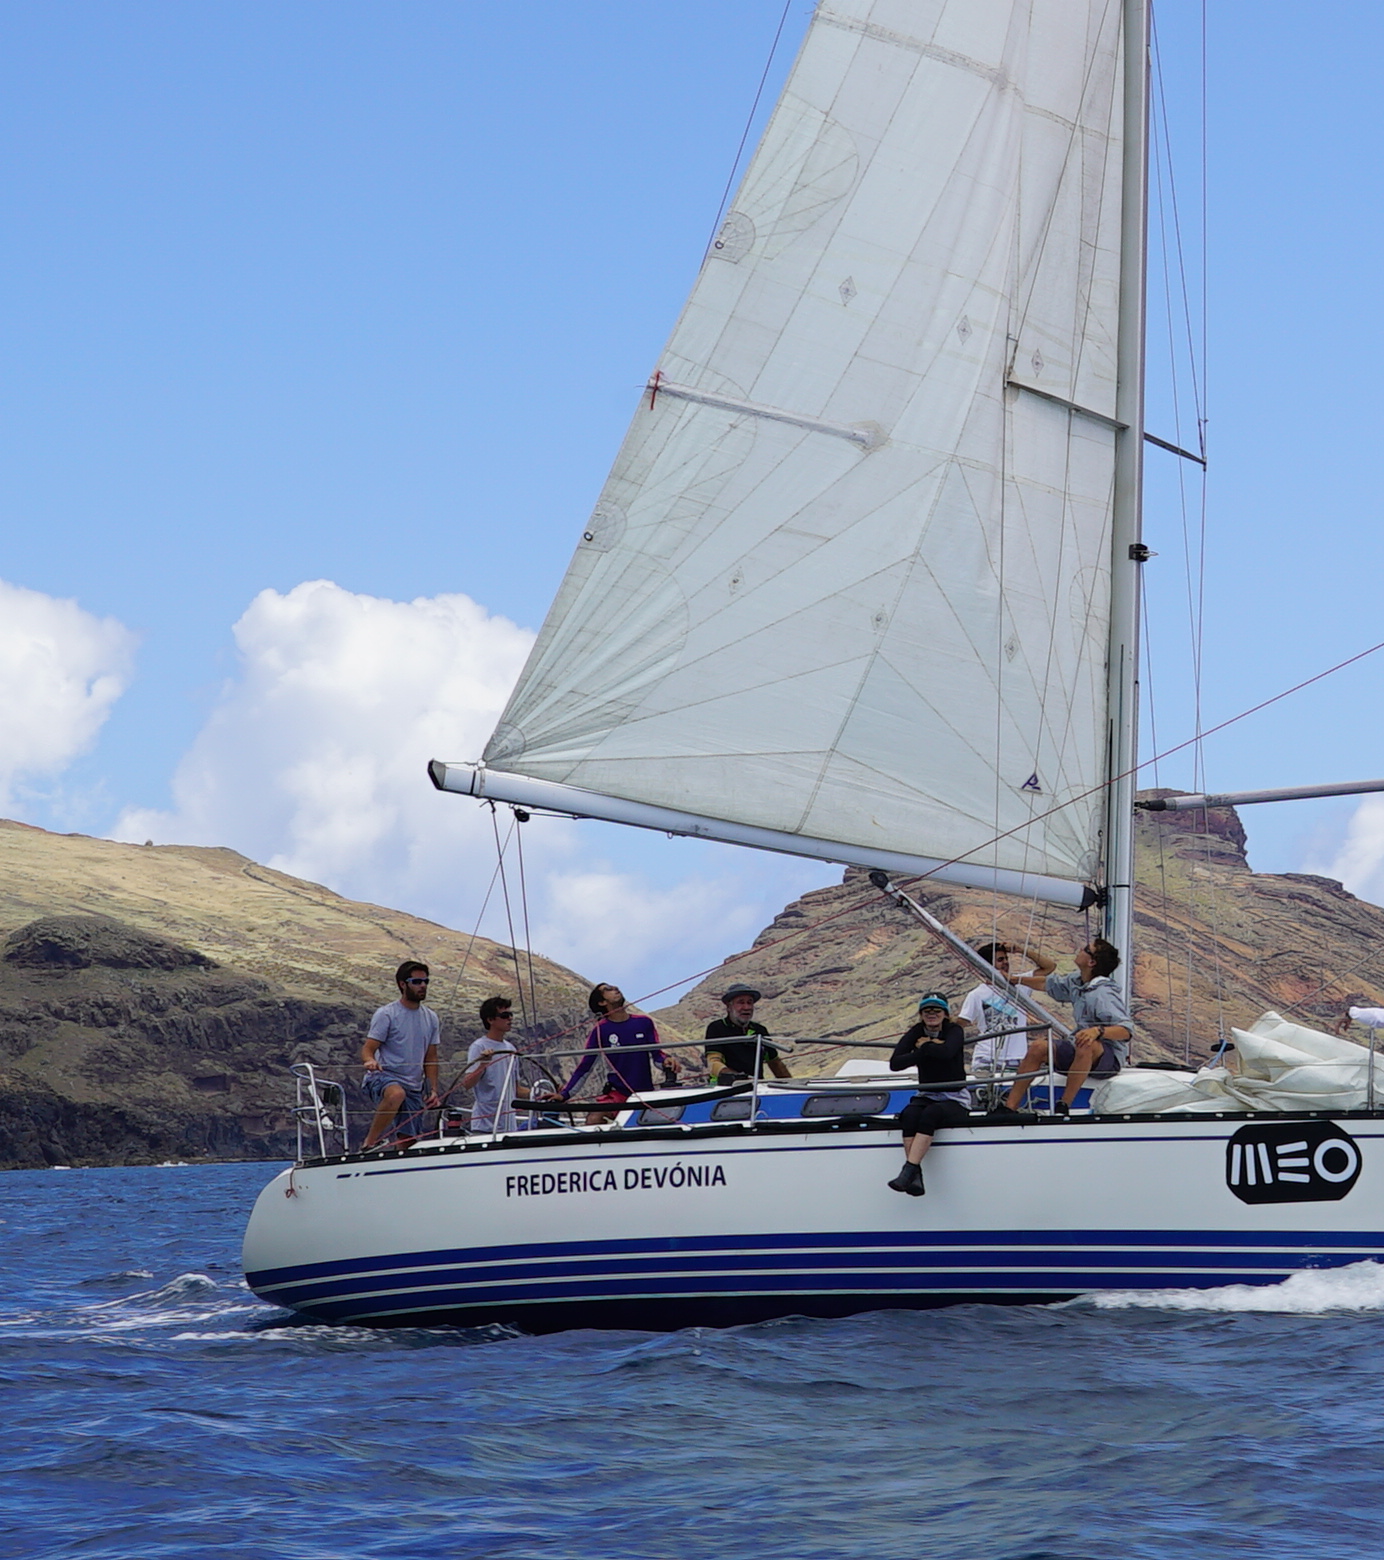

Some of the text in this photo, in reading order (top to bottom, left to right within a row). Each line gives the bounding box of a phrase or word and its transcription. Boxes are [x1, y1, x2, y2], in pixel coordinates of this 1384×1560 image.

[505, 1161, 727, 1198] FREDERICA DEVÓNIA
[1230, 1138, 1358, 1186] MEO
